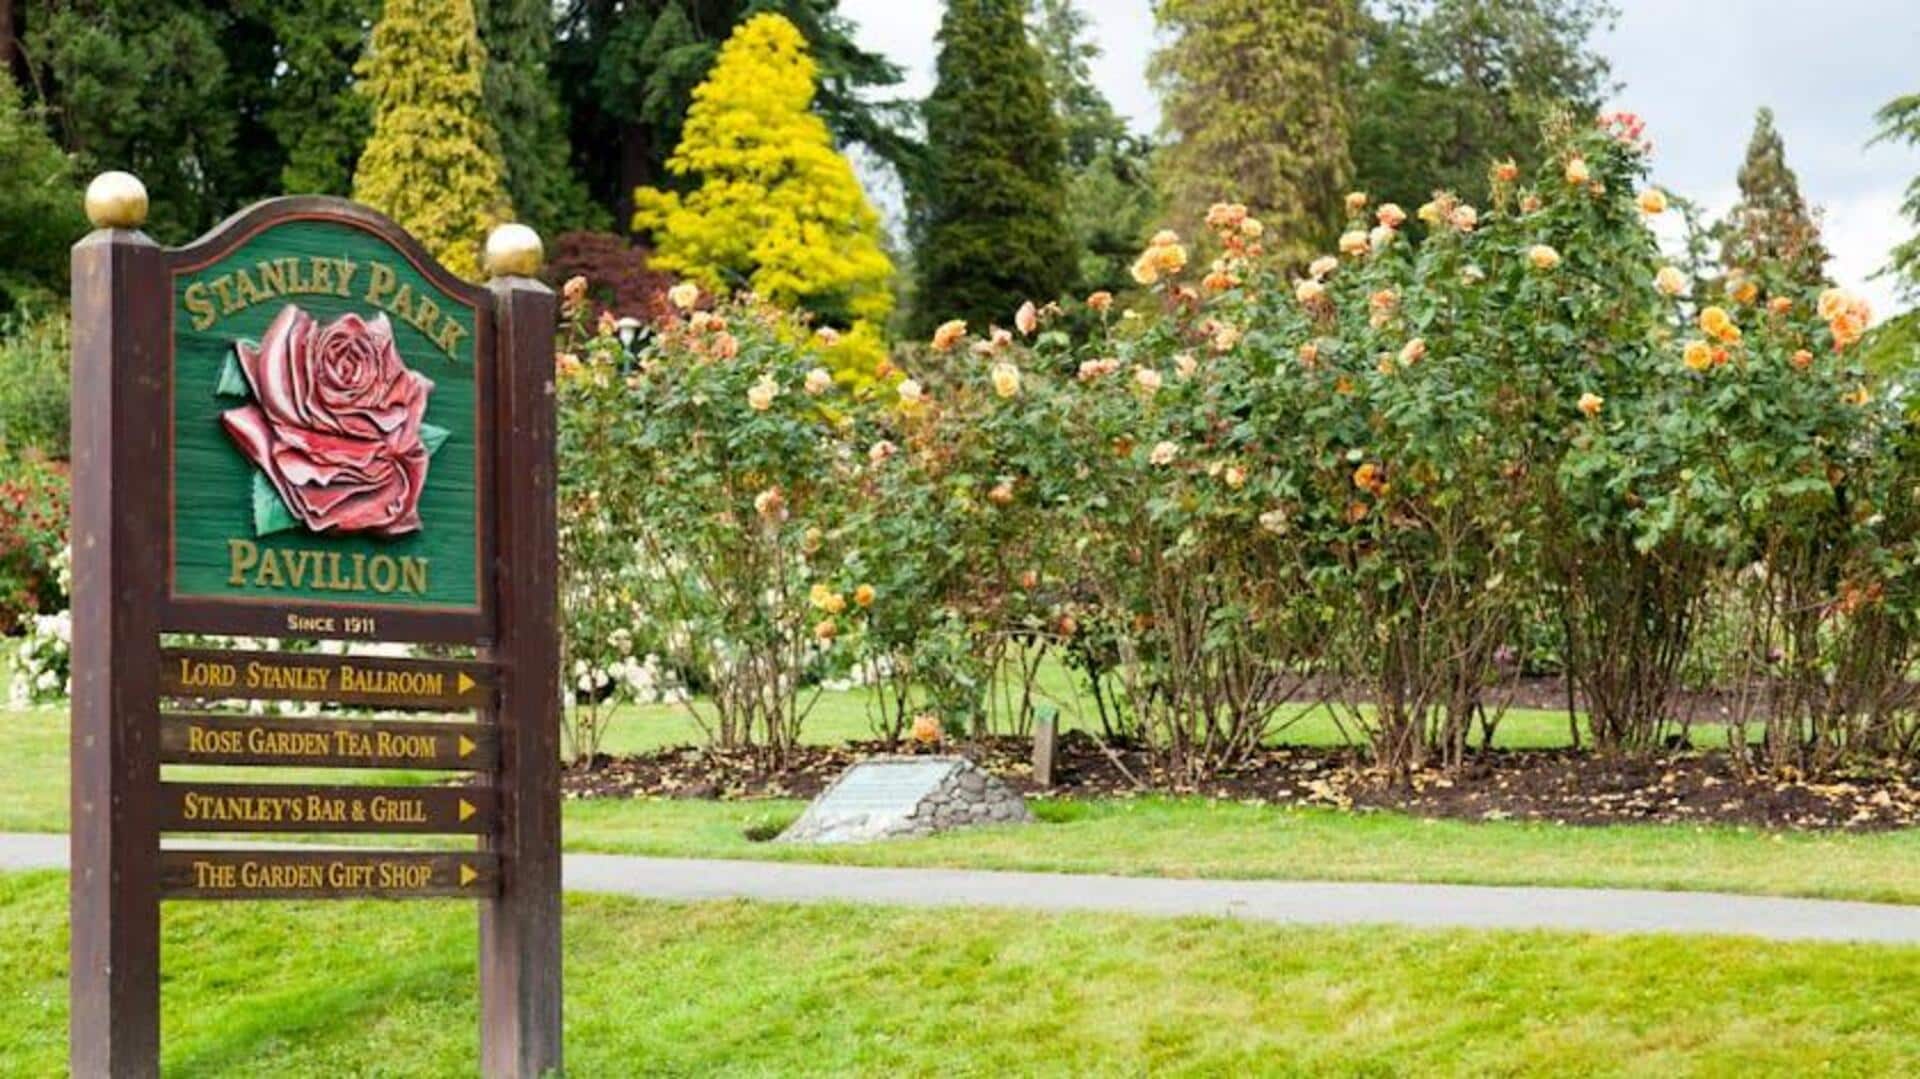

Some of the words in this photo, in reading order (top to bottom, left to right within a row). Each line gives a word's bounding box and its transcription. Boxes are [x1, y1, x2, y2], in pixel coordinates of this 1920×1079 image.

[184, 256, 357, 331] STANLEY
[364, 261, 469, 360] PARK
[227, 539, 429, 594] PAVILION
[287, 613, 335, 632] SINCE
[344, 616, 376, 633] 1911
[181, 658, 236, 687] LORD
[246, 661, 331, 691] STANLEY
[340, 666, 443, 695] BALLROOM
[188, 726, 243, 753] ROSE
[248, 727, 329, 755] GARDEN
[334, 730, 373, 756] TEA
[376, 730, 437, 758] ROOM
[183, 792, 302, 821] STANLEY'S
[306, 795, 346, 822] BAR
[351, 802, 366, 822] &
[370, 796, 427, 823] GRILL
[193, 861, 236, 888] THE
[241, 861, 323, 889] GARDEN
[328, 862, 376, 889] GIFT
[379, 861, 432, 889] SHOP
